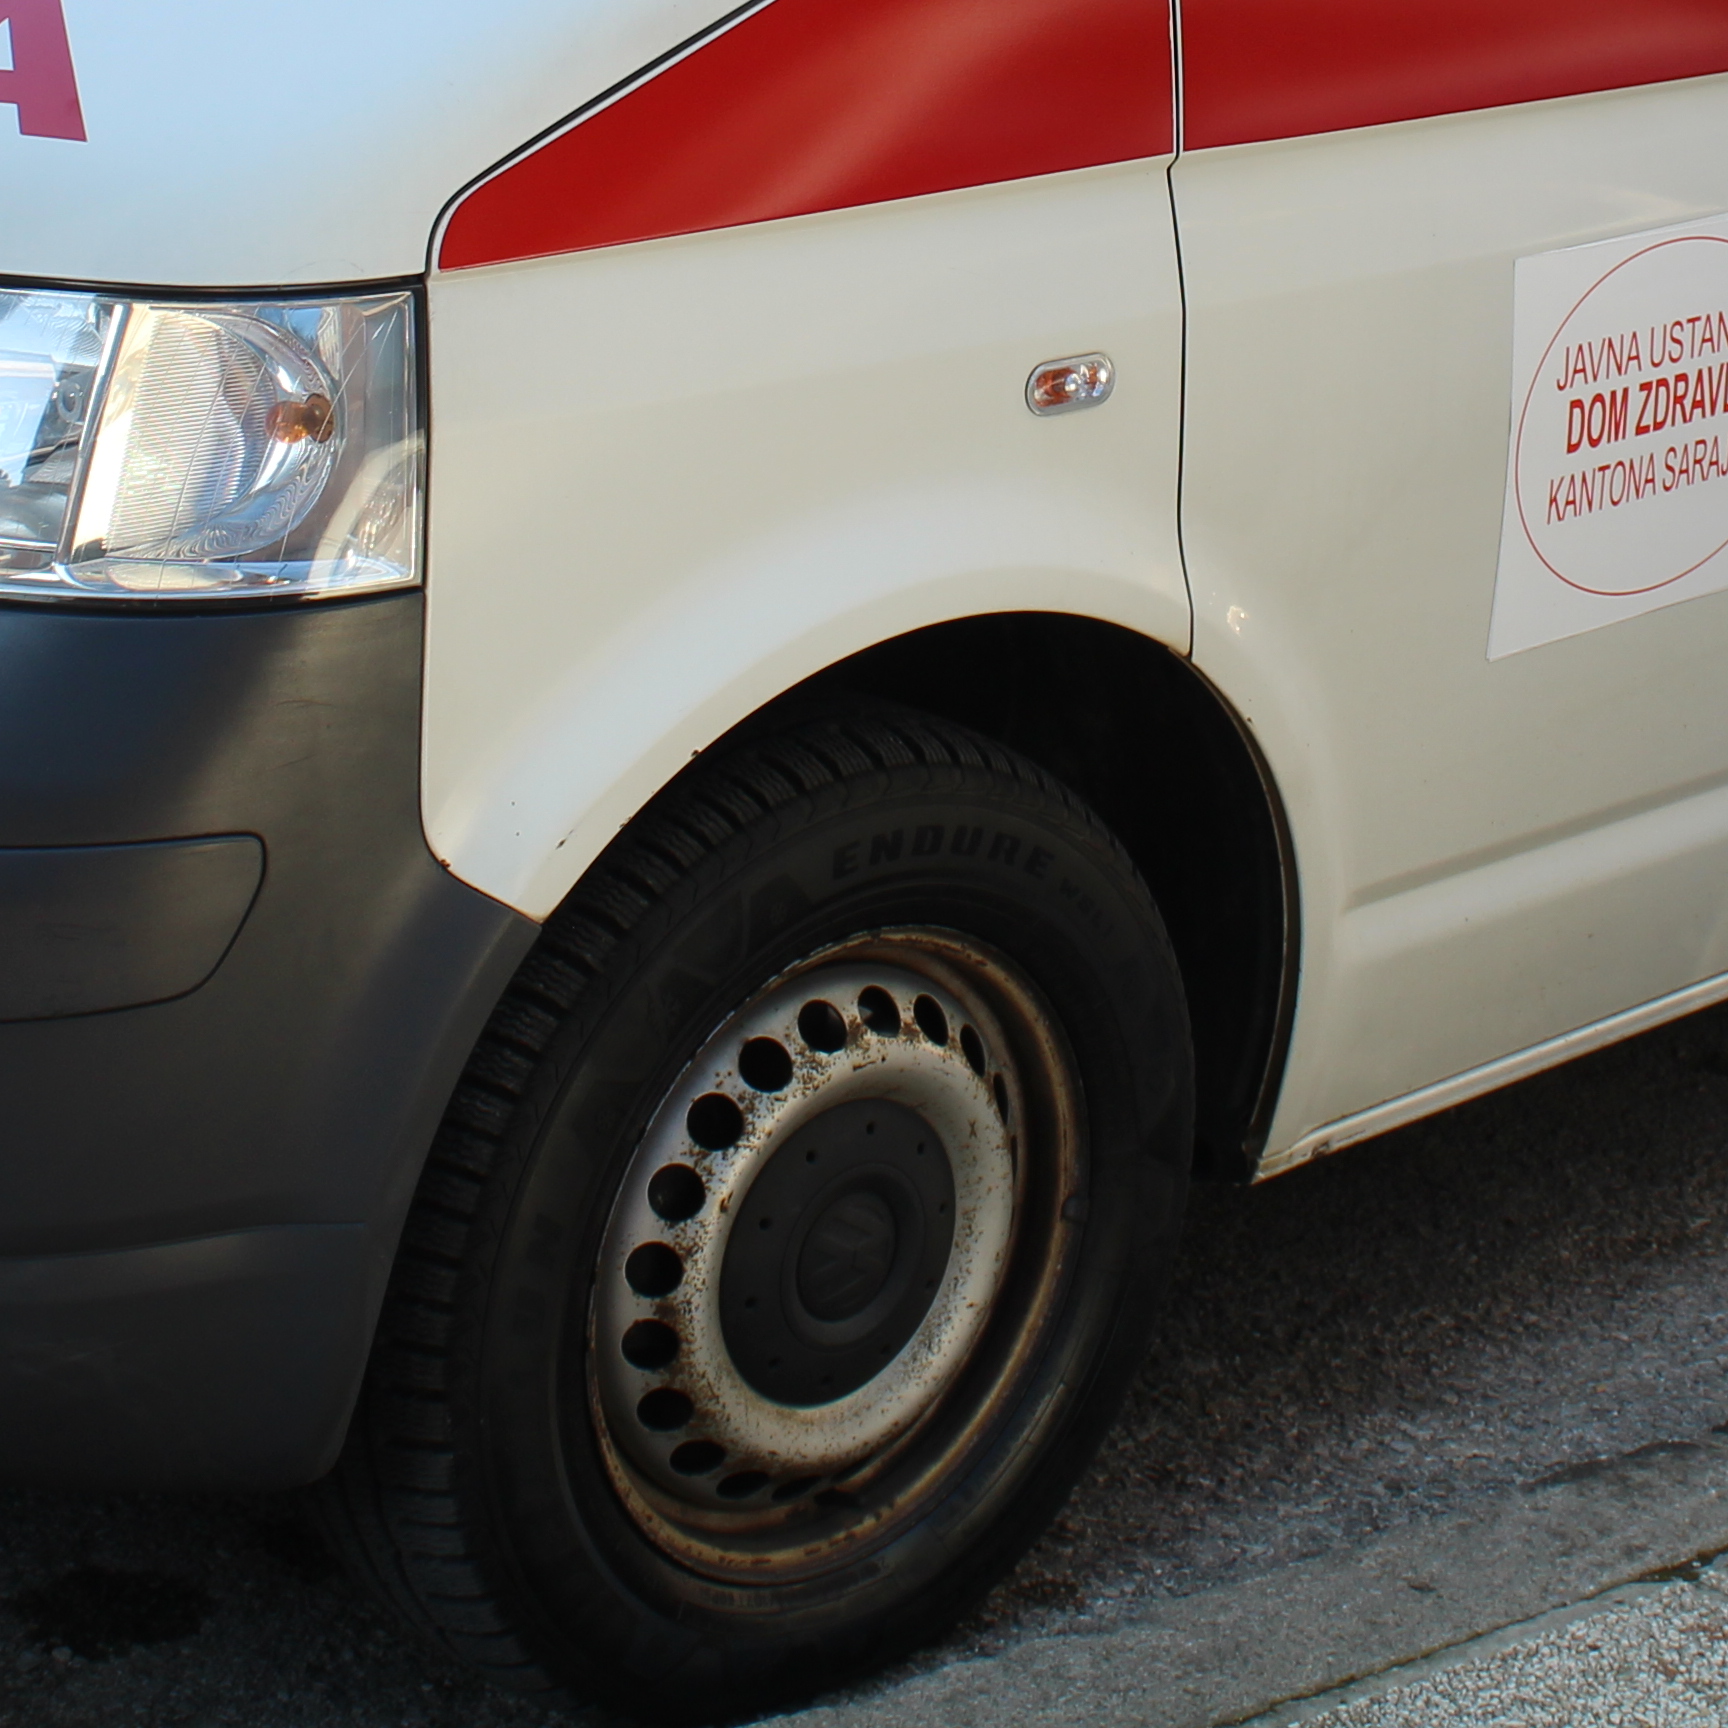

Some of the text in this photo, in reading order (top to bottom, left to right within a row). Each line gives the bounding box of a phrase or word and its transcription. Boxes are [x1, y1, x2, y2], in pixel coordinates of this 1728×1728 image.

[1555, 330, 1643, 392] JAVNA
[1565, 386, 1630, 455] DOM
[1546, 452, 1658, 526] KANTONA
[832, 823, 1057, 881] ENDURE
